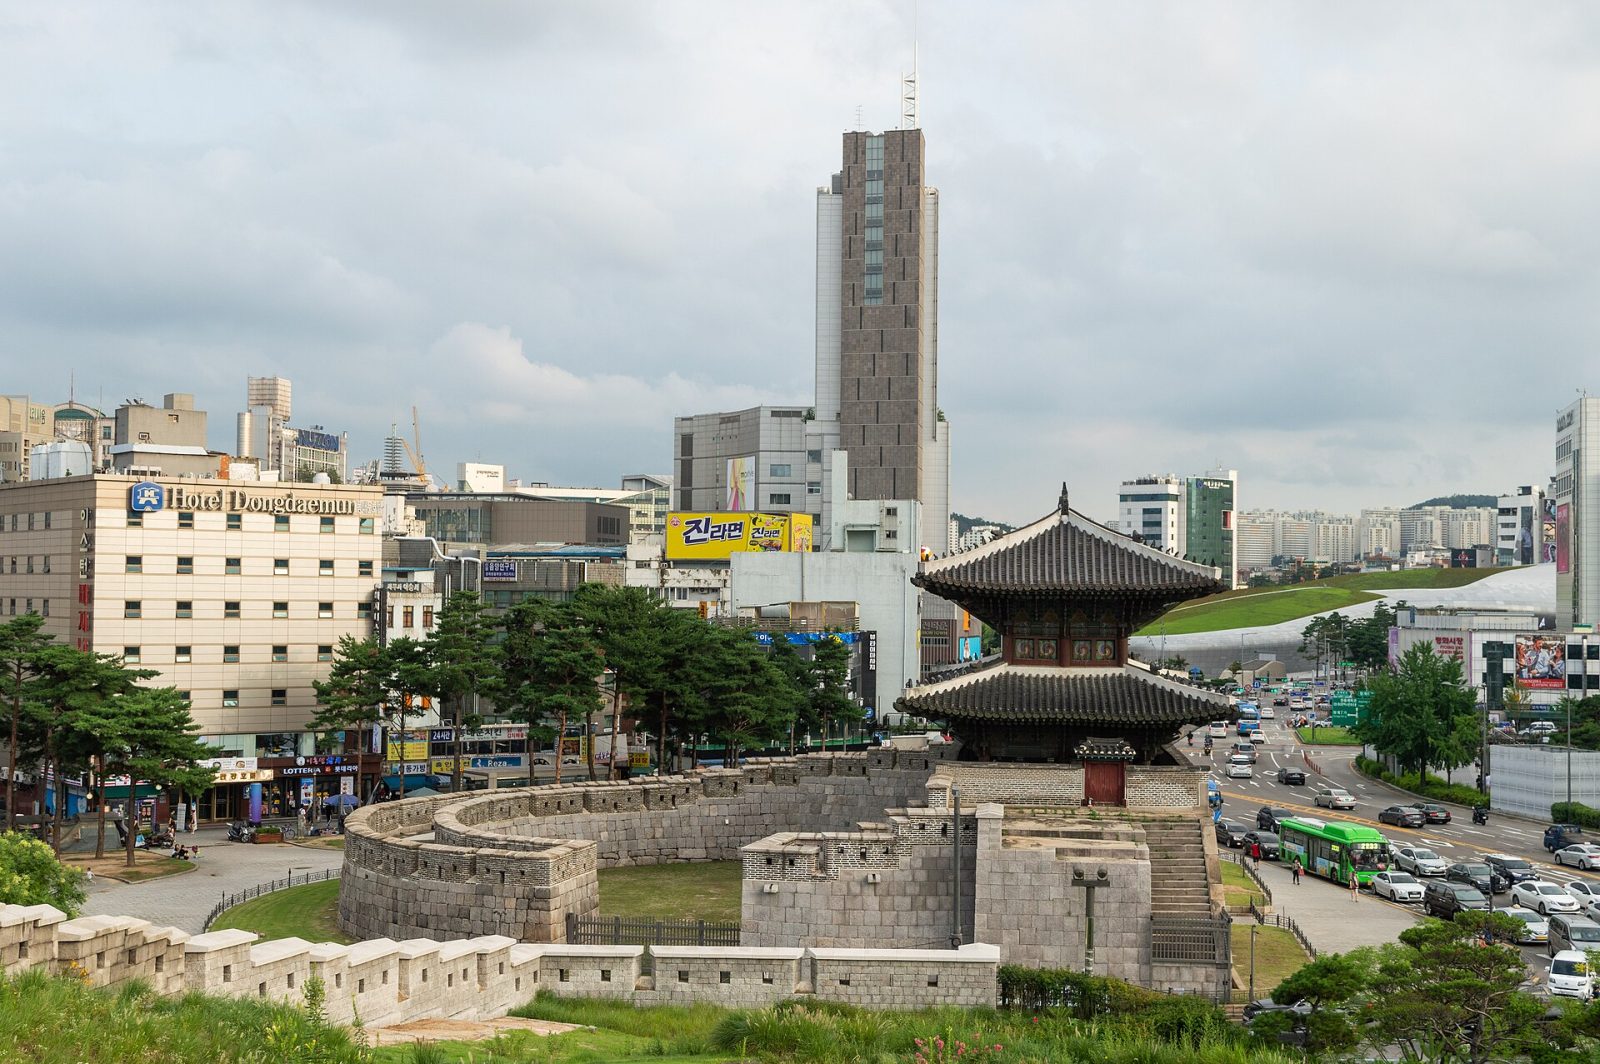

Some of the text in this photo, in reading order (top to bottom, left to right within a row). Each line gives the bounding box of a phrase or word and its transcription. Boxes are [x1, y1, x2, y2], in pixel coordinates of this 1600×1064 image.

[297, 428, 339, 452] NUZZON
[171, 487, 223, 510] Hotel
[234, 489, 356, 516] Dongdaemun
[683, 516, 744, 546] 진라면
[751, 526, 780, 539] 진라면
[80, 507, 89, 579] 이스턴
[1435, 637, 1463, 645] 평화시장
[432, 731, 451, 740] 24시간
[283, 767, 321, 775] LOTTERIA
[334, 765, 359, 773] 롯데리아
